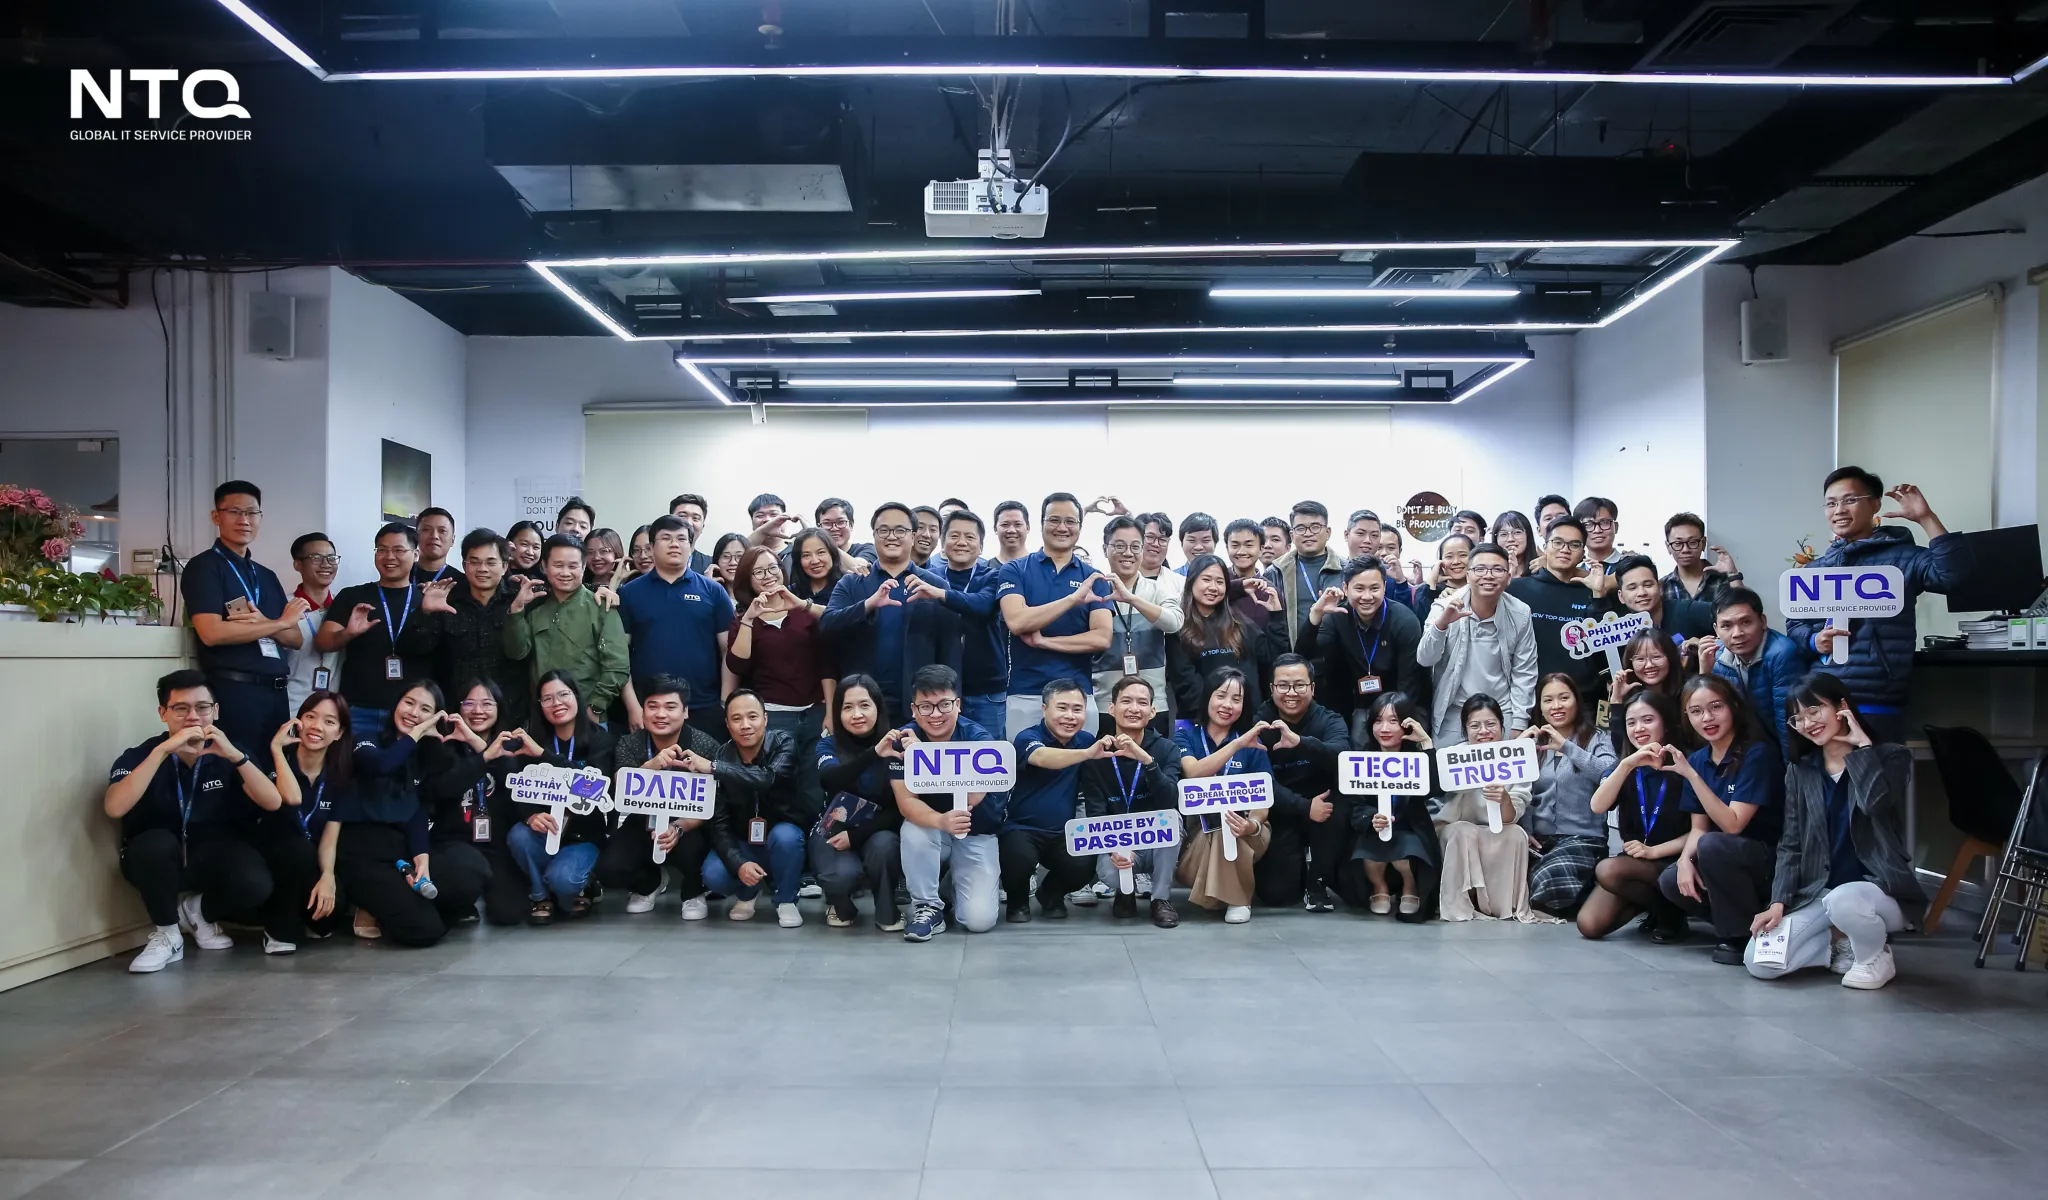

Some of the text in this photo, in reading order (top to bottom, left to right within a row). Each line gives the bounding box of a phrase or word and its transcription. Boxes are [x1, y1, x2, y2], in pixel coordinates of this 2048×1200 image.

[522, 496, 552, 504] TOUGH
[1397, 505, 1457, 517] DON'T BE BUSY
[1396, 519, 1406, 528] BE
[1789, 573, 1896, 601] NTQ
[684, 594, 701, 602] NTQ
[1859, 604, 1897, 612] PROVIDER
[913, 748, 1009, 776] NTQ
[1446, 746, 1525, 765] Build On
[1348, 756, 1421, 778] TECH
[1449, 760, 1527, 787] TRUST
[202, 779, 223, 790] NTQ
[510, 776, 562, 790] BẬC THẦY
[625, 772, 706, 802] DARE
[940, 780, 946, 788] IT
[975, 779, 1009, 787] PROVIDER
[1349, 780, 1421, 790] That Leads
[517, 789, 540, 799] SUY
[541, 791, 568, 803] TÍNH
[1183, 779, 1267, 808] DARE
[1197, 790, 1225, 799] BREAK
[1226, 787, 1266, 797] THROUGH
[320, 800, 332, 808] NT
[623, 798, 704, 813] Beyond Limits
[1088, 816, 1156, 833] MADE BY
[1073, 828, 1173, 852] PASSION
